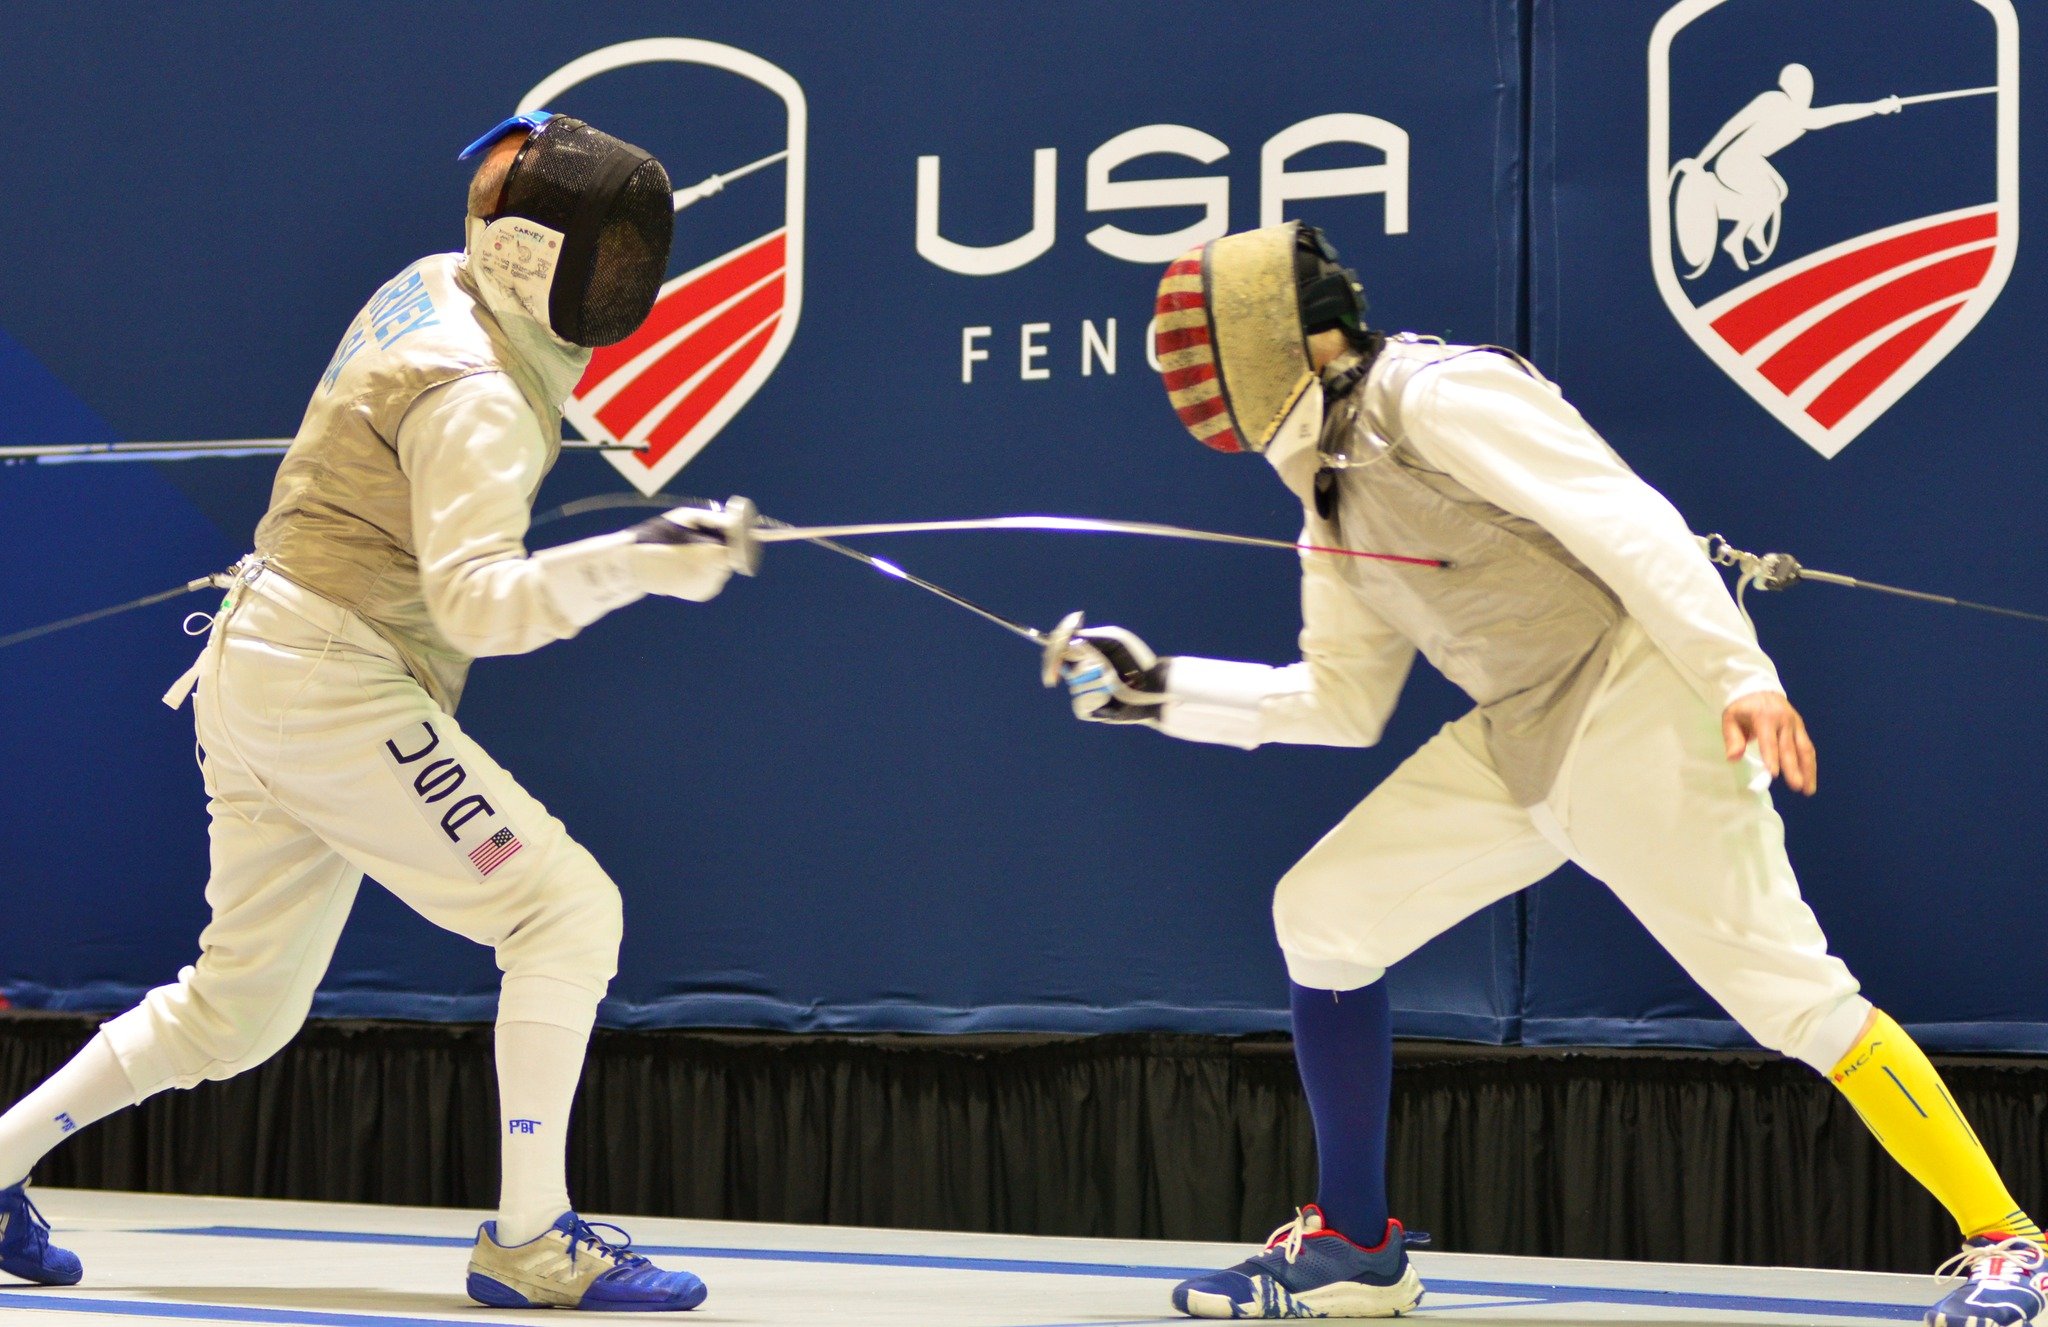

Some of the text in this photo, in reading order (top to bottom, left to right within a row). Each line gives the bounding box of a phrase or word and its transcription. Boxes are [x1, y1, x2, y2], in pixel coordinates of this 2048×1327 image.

[916, 113, 1409, 276] USA
[385, 721, 496, 843] USA
[509, 1119, 541, 1134] PBT
